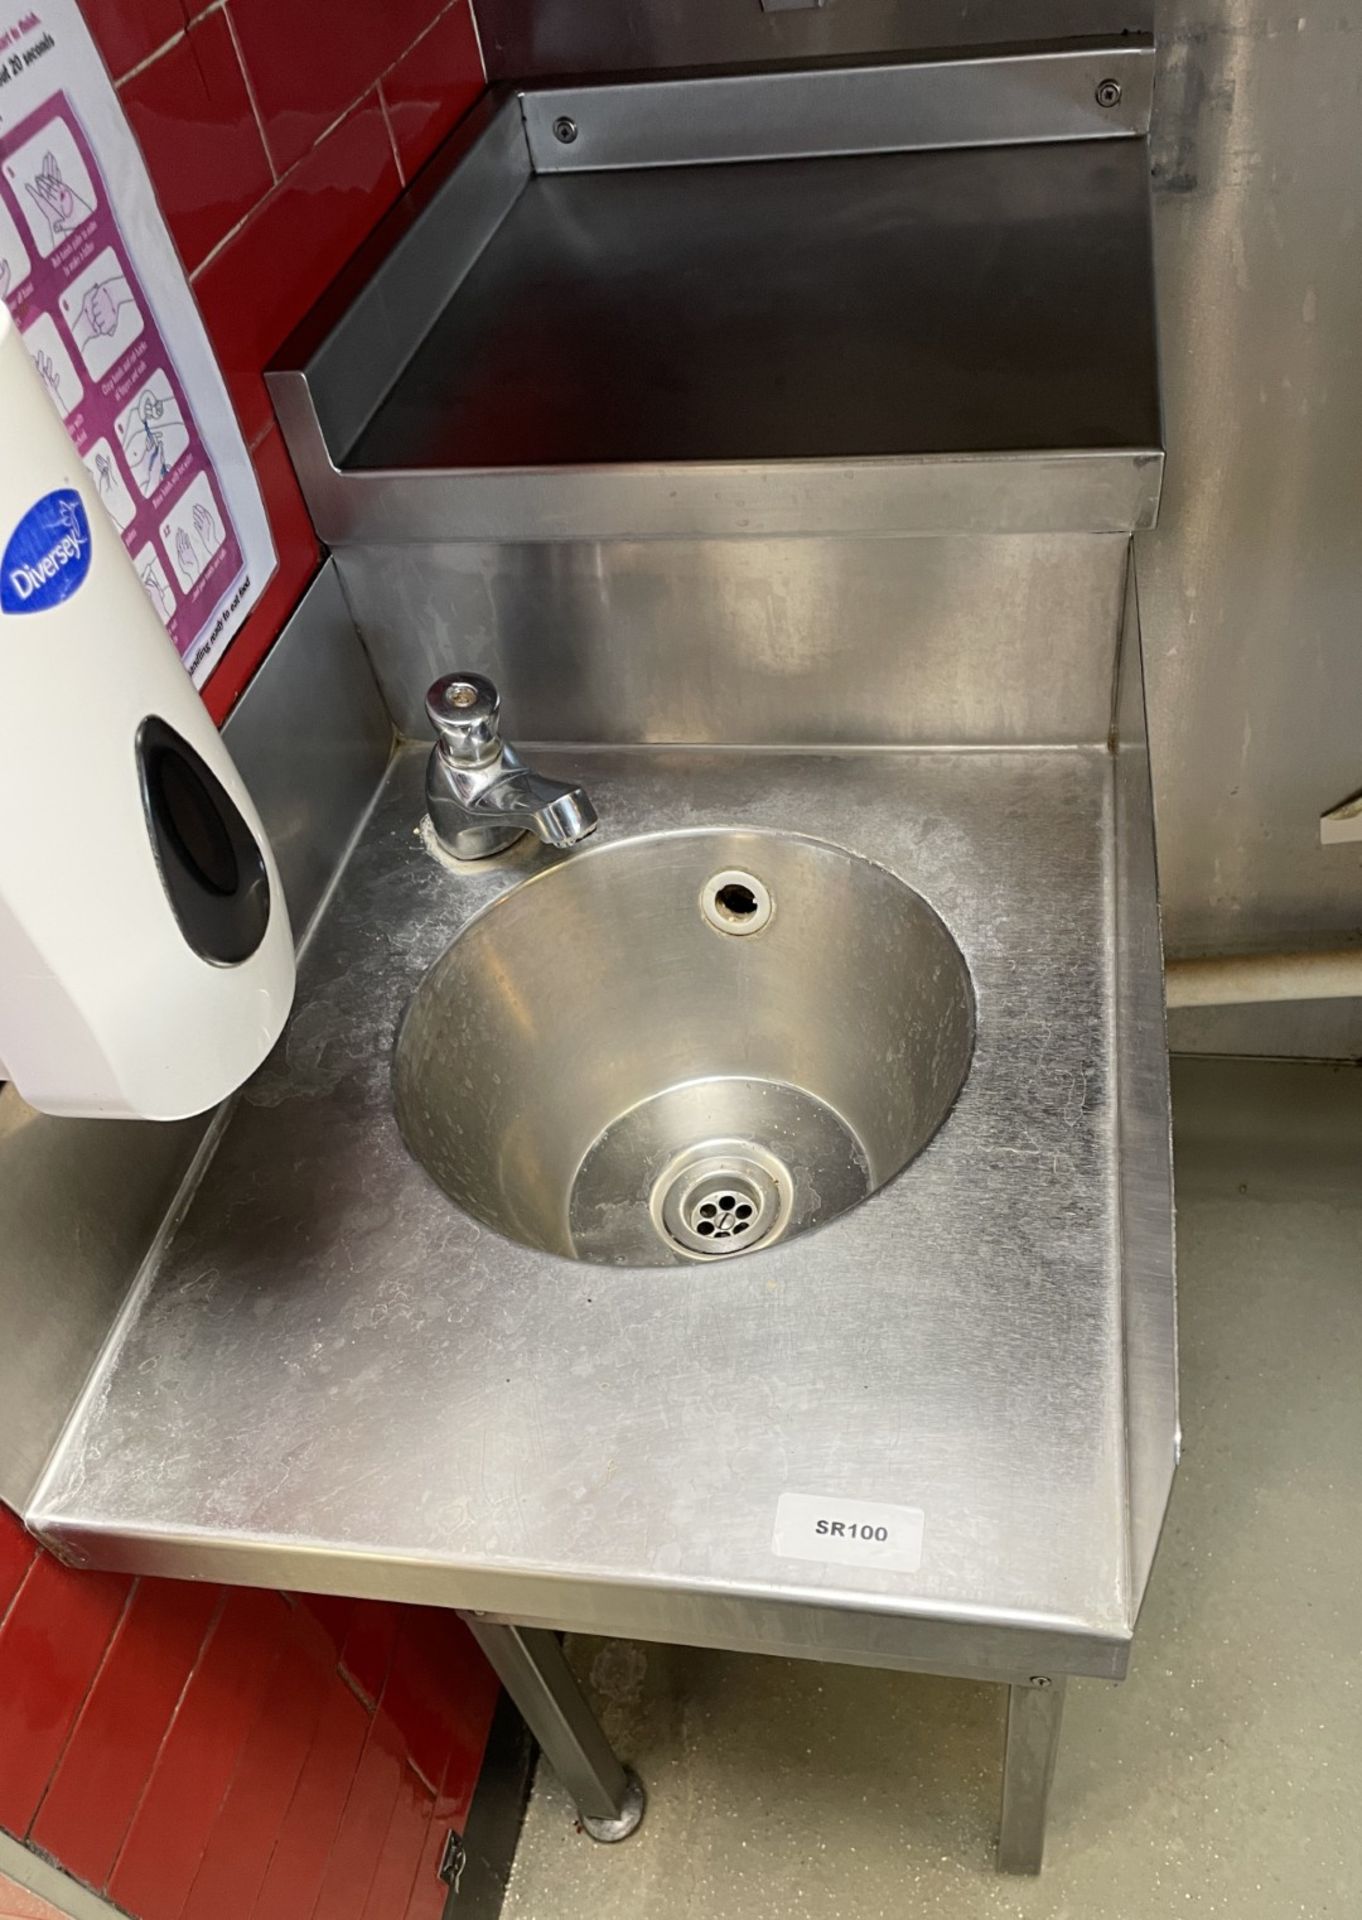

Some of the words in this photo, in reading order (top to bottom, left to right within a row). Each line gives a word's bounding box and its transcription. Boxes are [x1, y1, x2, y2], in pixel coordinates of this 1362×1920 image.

[10, 529, 82, 601] Diversey
[221, 609, 231, 622] to
[815, 1519, 889, 1542] SR100
